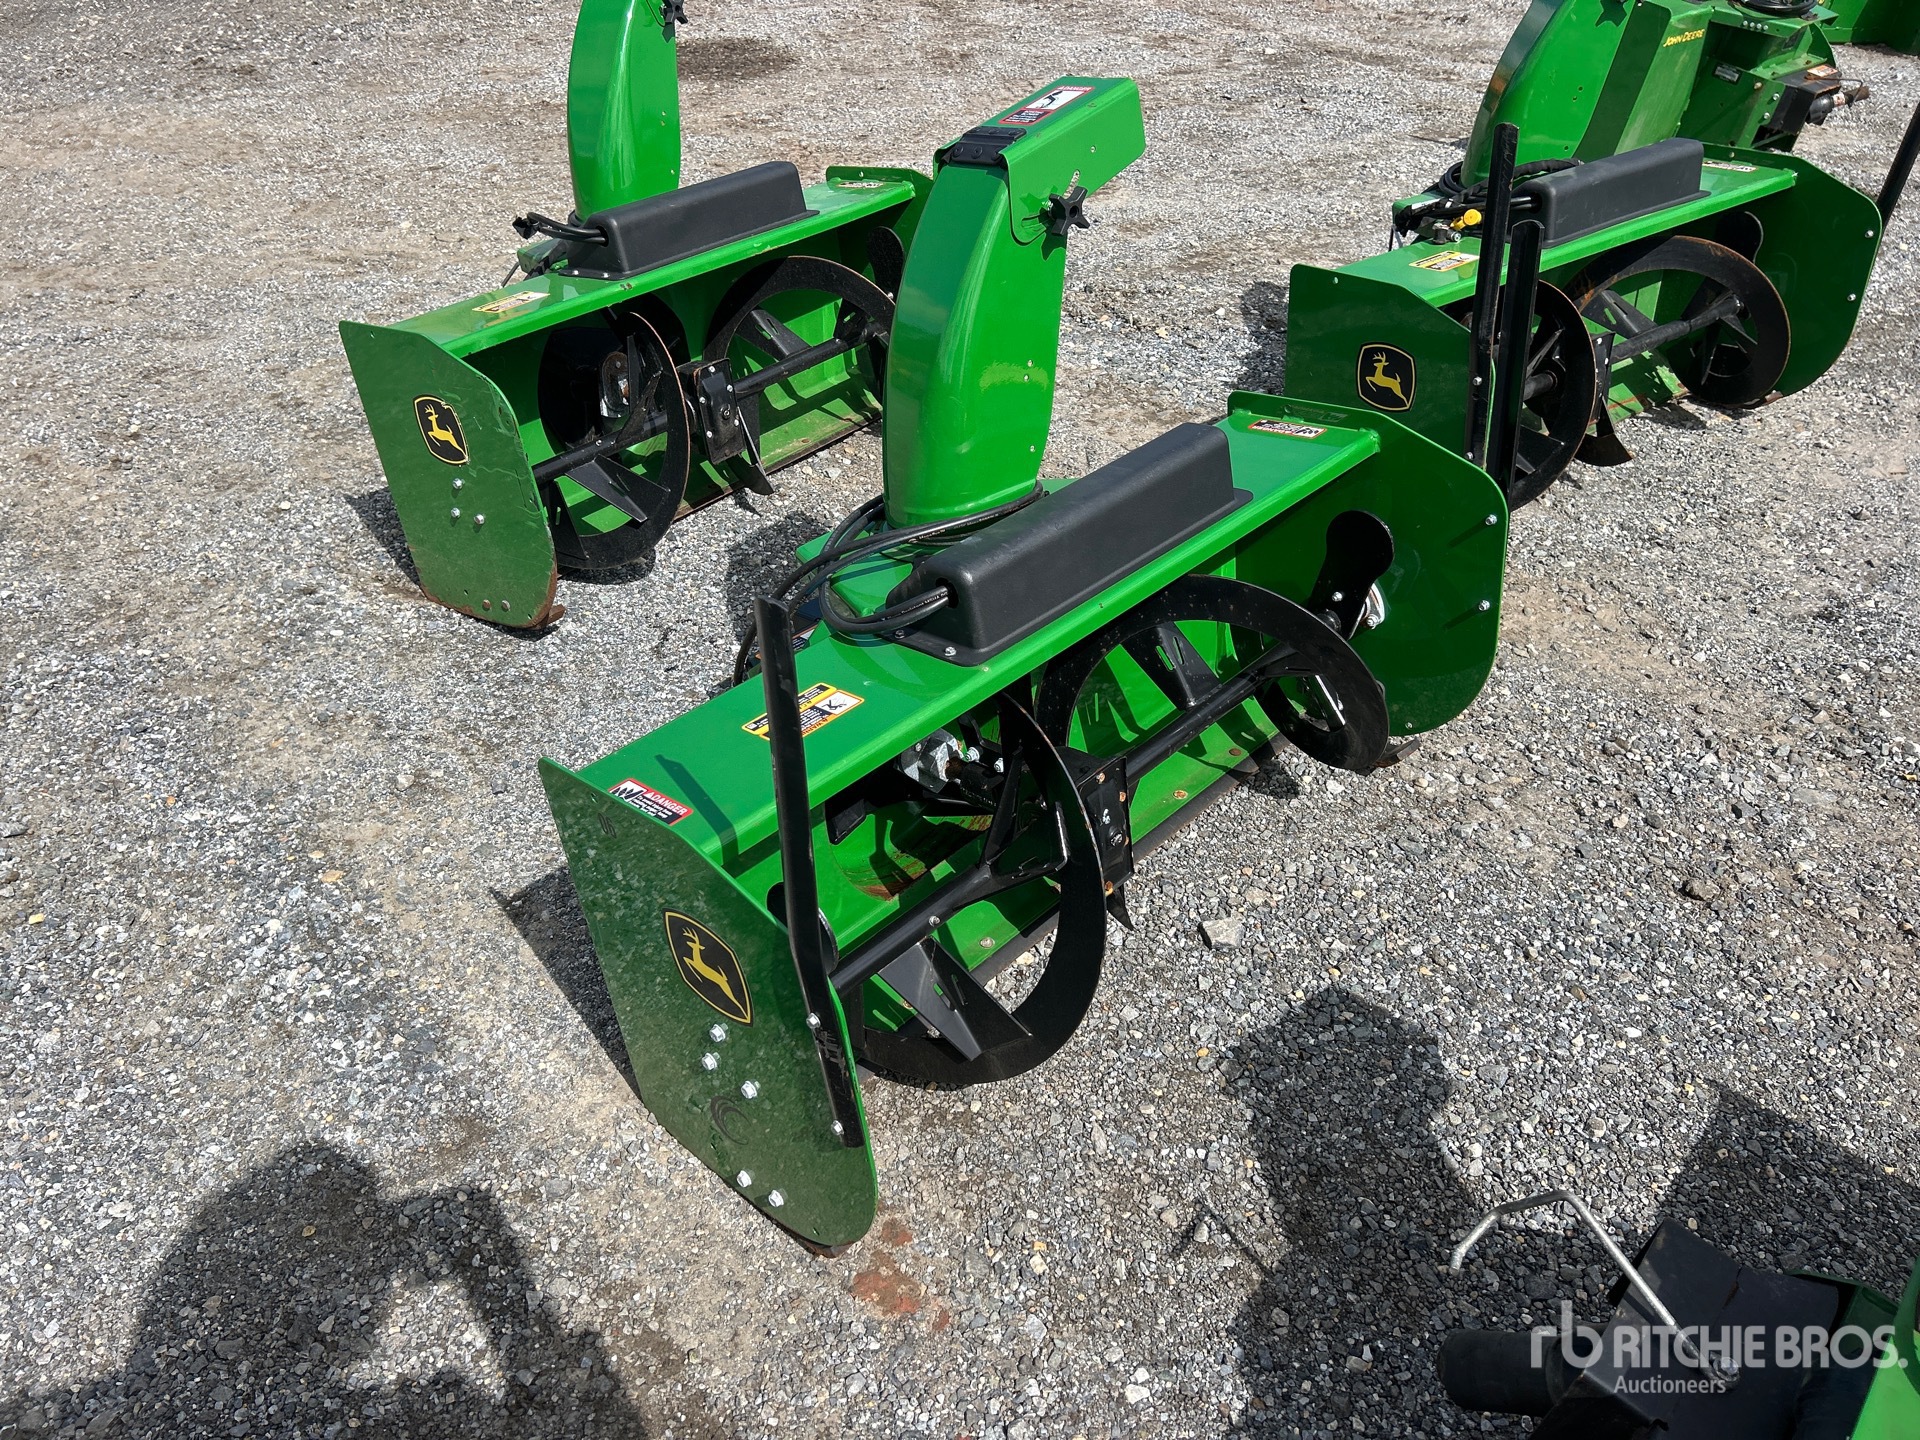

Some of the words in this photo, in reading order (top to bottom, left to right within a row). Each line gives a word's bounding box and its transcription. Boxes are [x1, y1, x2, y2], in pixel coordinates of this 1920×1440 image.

[1663, 35, 1684, 47] JOHN
[1682, 29, 1705, 42] DEERE
[651, 794, 688, 815] DANGER
